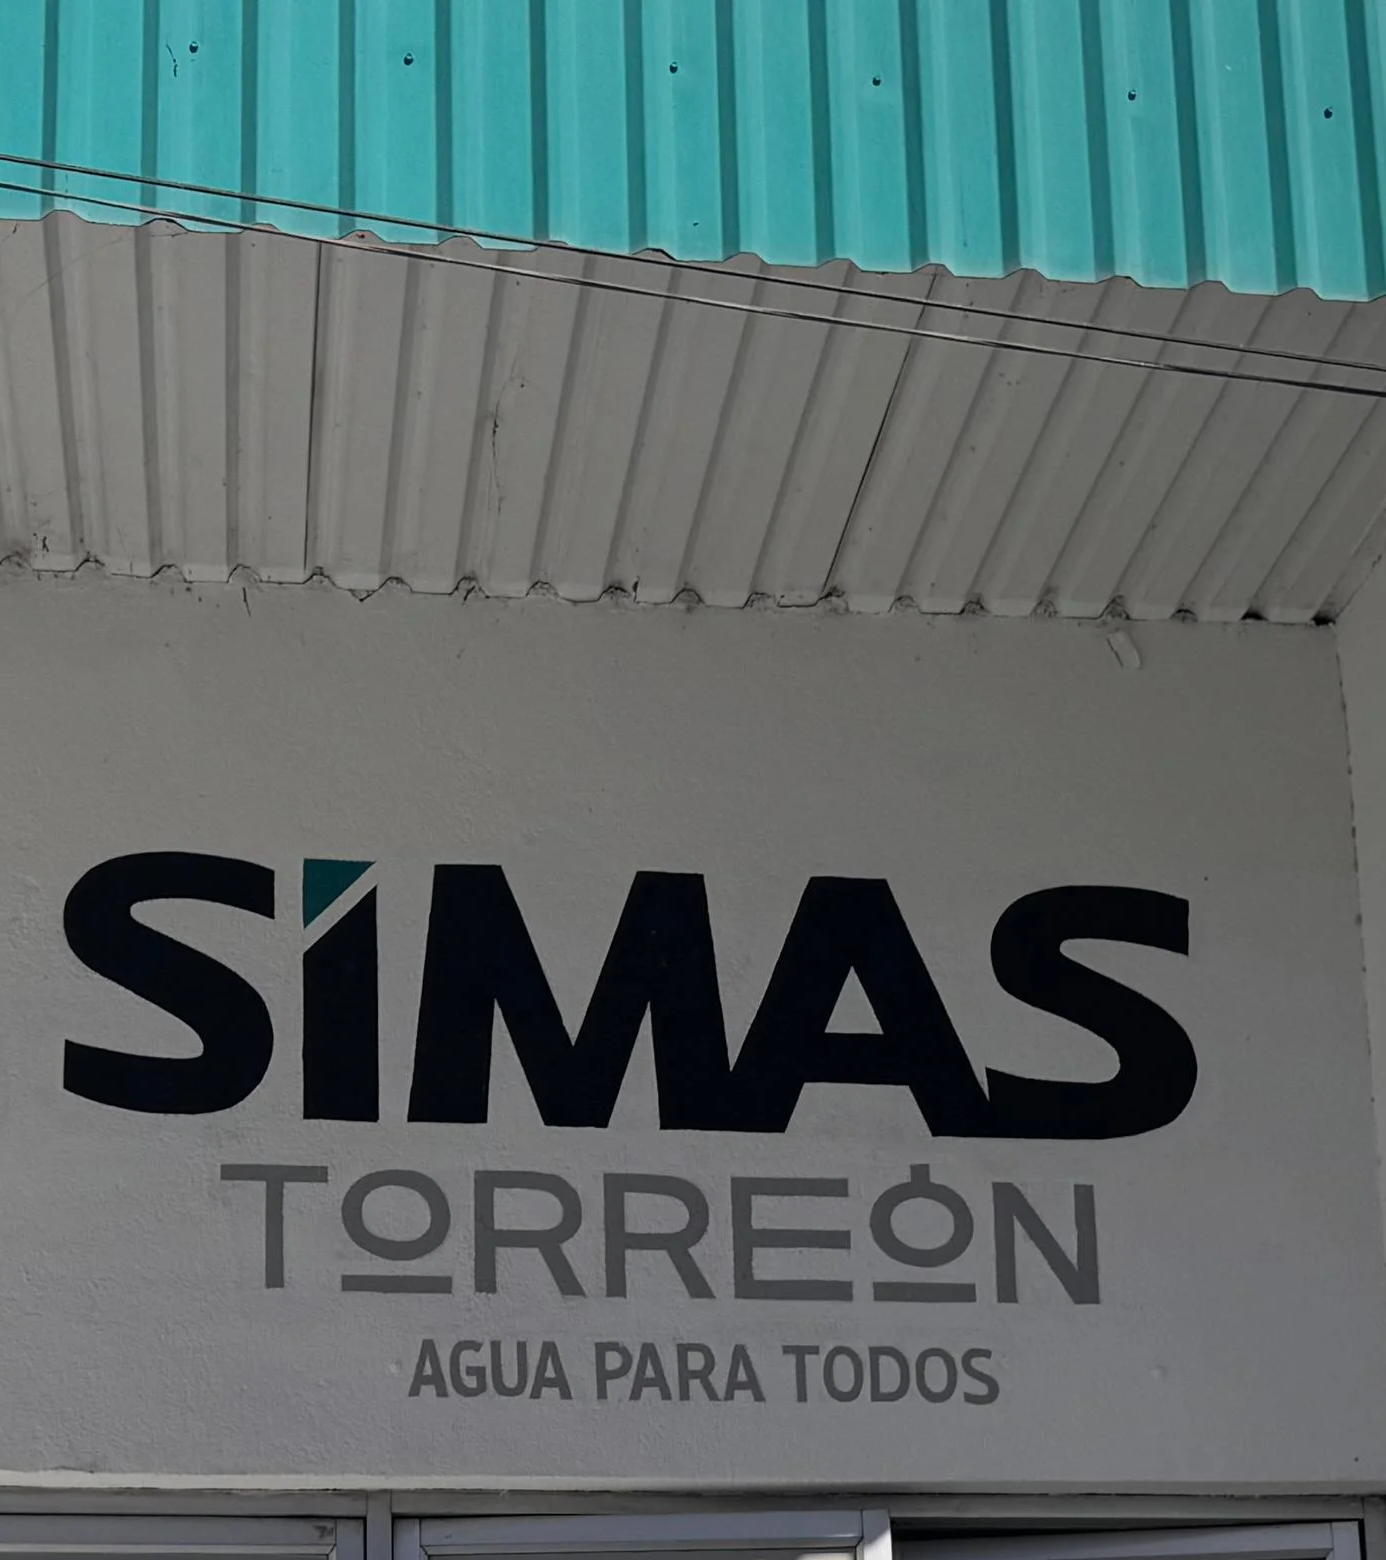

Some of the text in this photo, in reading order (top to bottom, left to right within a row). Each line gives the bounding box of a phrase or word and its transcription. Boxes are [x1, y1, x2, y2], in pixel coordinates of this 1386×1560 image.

[219, 1163, 1102, 1306] TORREÓN
[408, 1338, 1000, 1406] AGUA PARA TODOS
